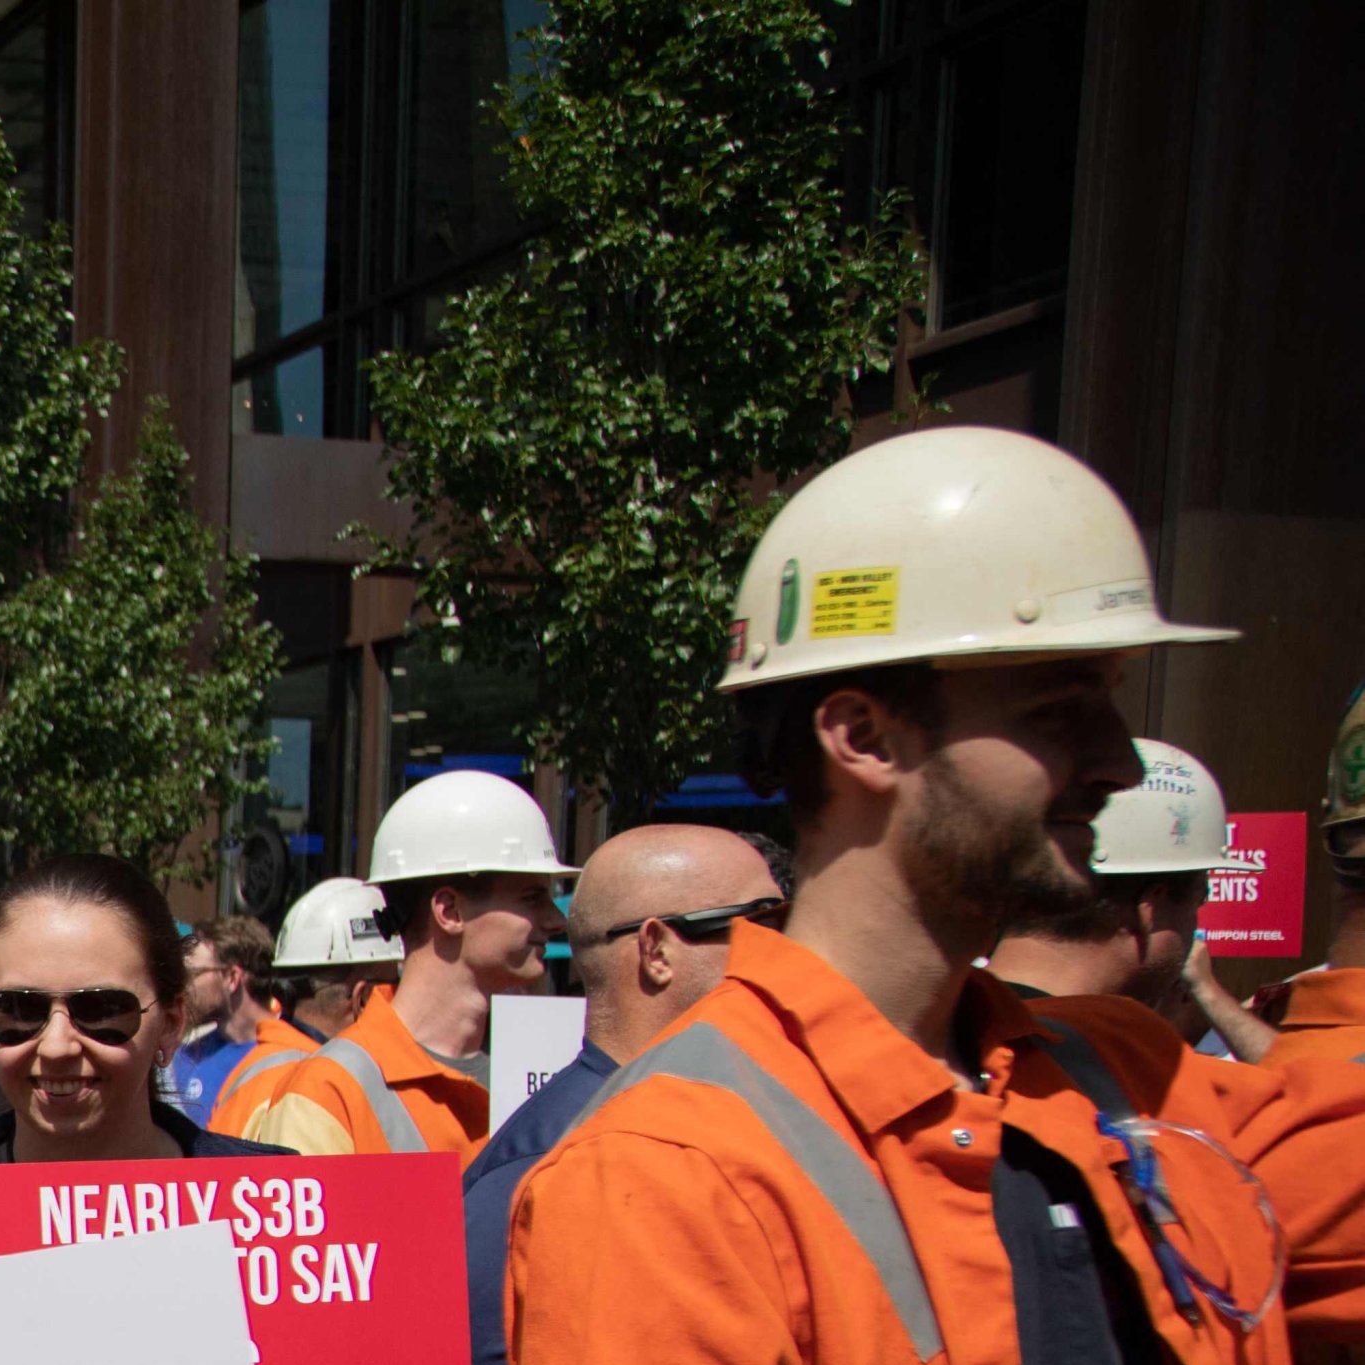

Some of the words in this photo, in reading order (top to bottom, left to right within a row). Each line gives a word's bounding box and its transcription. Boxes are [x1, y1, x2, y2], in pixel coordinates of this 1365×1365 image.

[1206, 929, 1248, 941] NIPPON
[1249, 930, 1286, 941] STEEL
[232, 1177, 326, 1243] $3B
[291, 1243, 378, 1304] SAY
